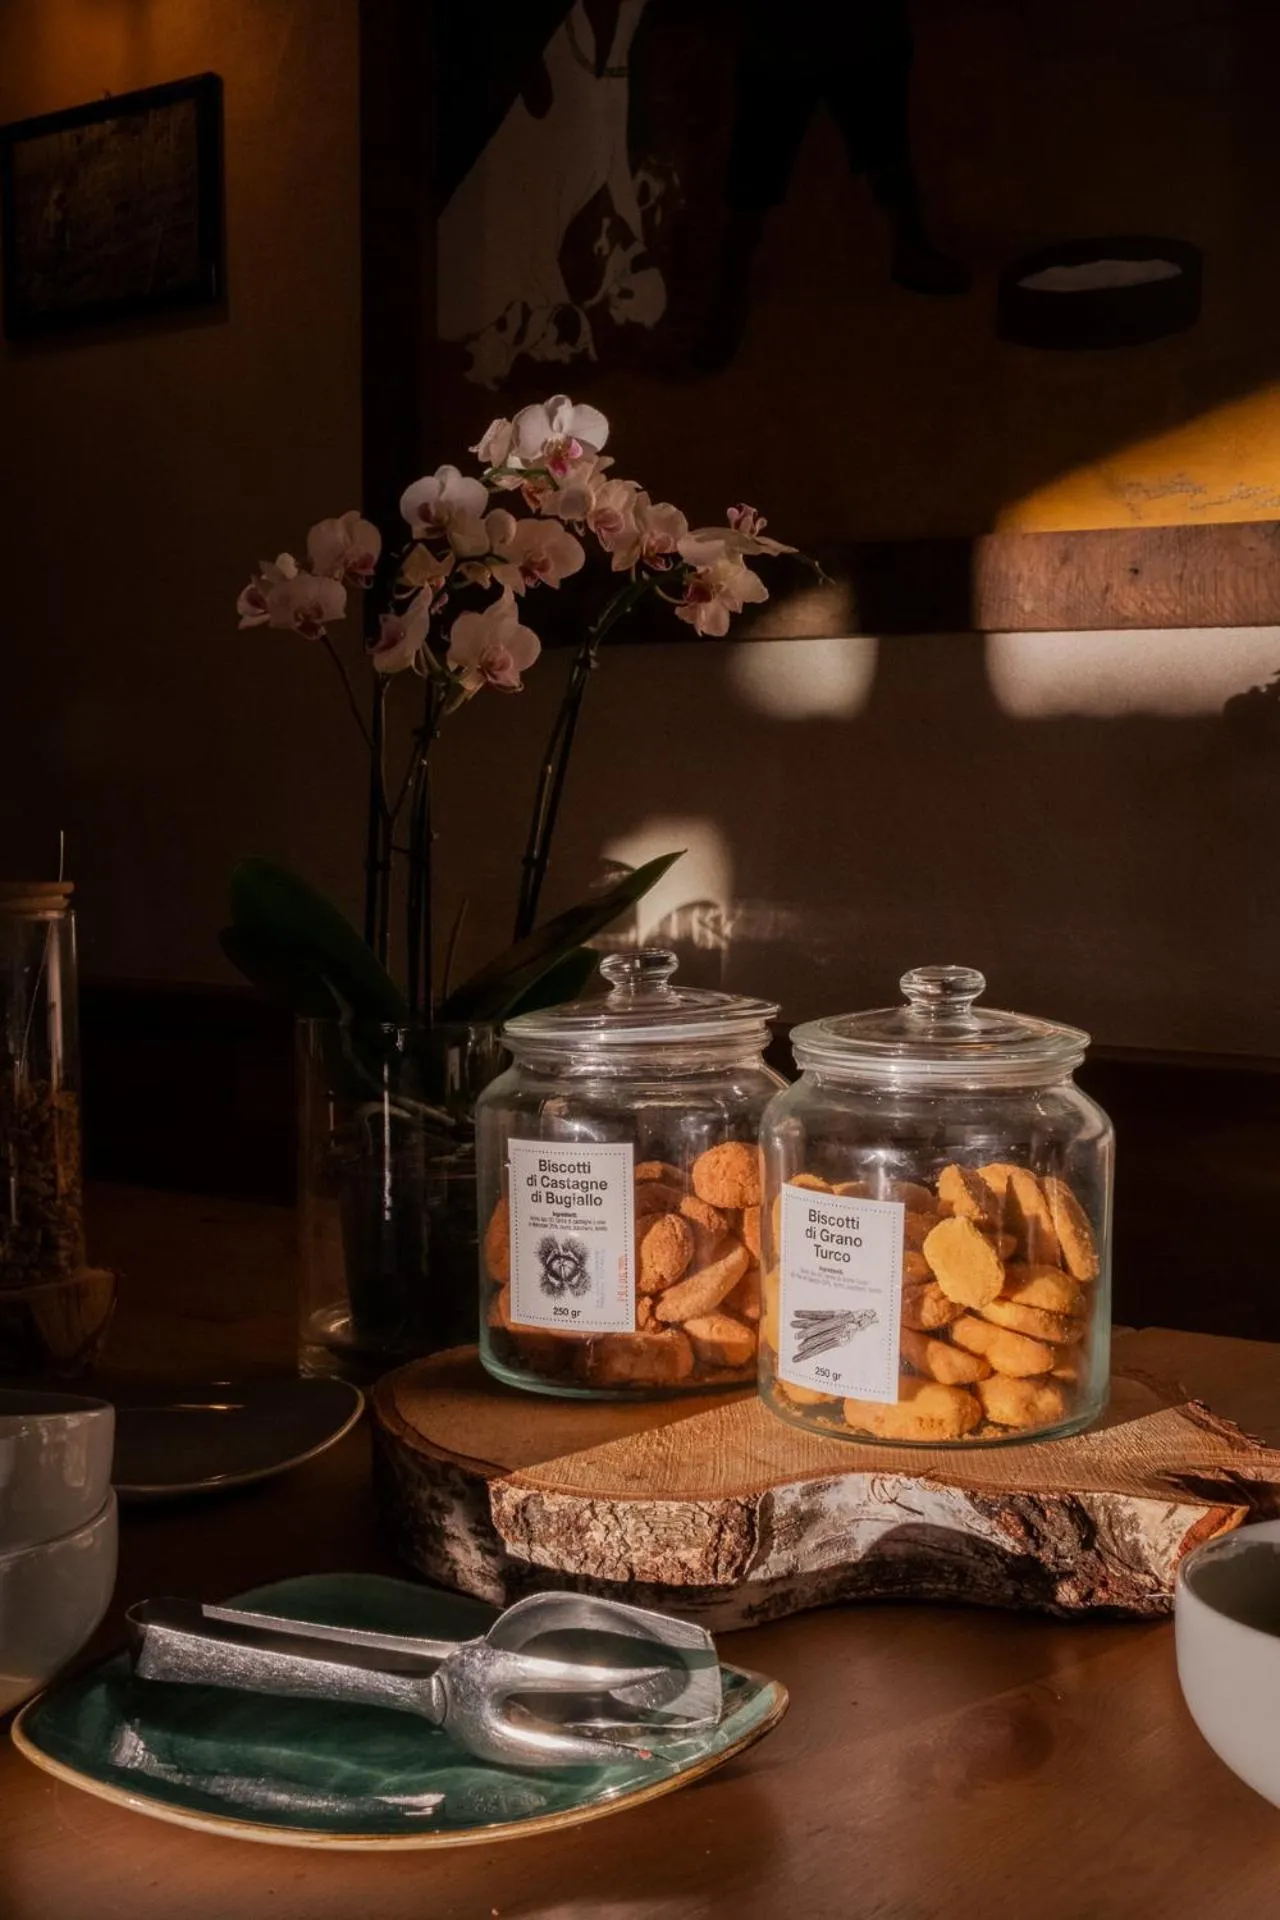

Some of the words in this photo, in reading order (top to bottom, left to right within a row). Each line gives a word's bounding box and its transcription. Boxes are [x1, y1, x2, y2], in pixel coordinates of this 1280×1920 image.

[538, 1159, 591, 1174] Biscotti
[526, 1174, 538, 1187] di
[540, 1175, 608, 1192] Castagne
[531, 1190, 542, 1204] di
[546, 1192, 603, 1208] Bugiallo
[808, 1208, 860, 1230] Biscotti
[805, 1226, 817, 1240] di
[819, 1229, 863, 1248] Grano
[813, 1244, 851, 1263] Turco
[553, 1306, 569, 1317] 250
[570, 1309, 582, 1319] gr
[814, 1366, 831, 1380] 250
[832, 1371, 843, 1382] gr
